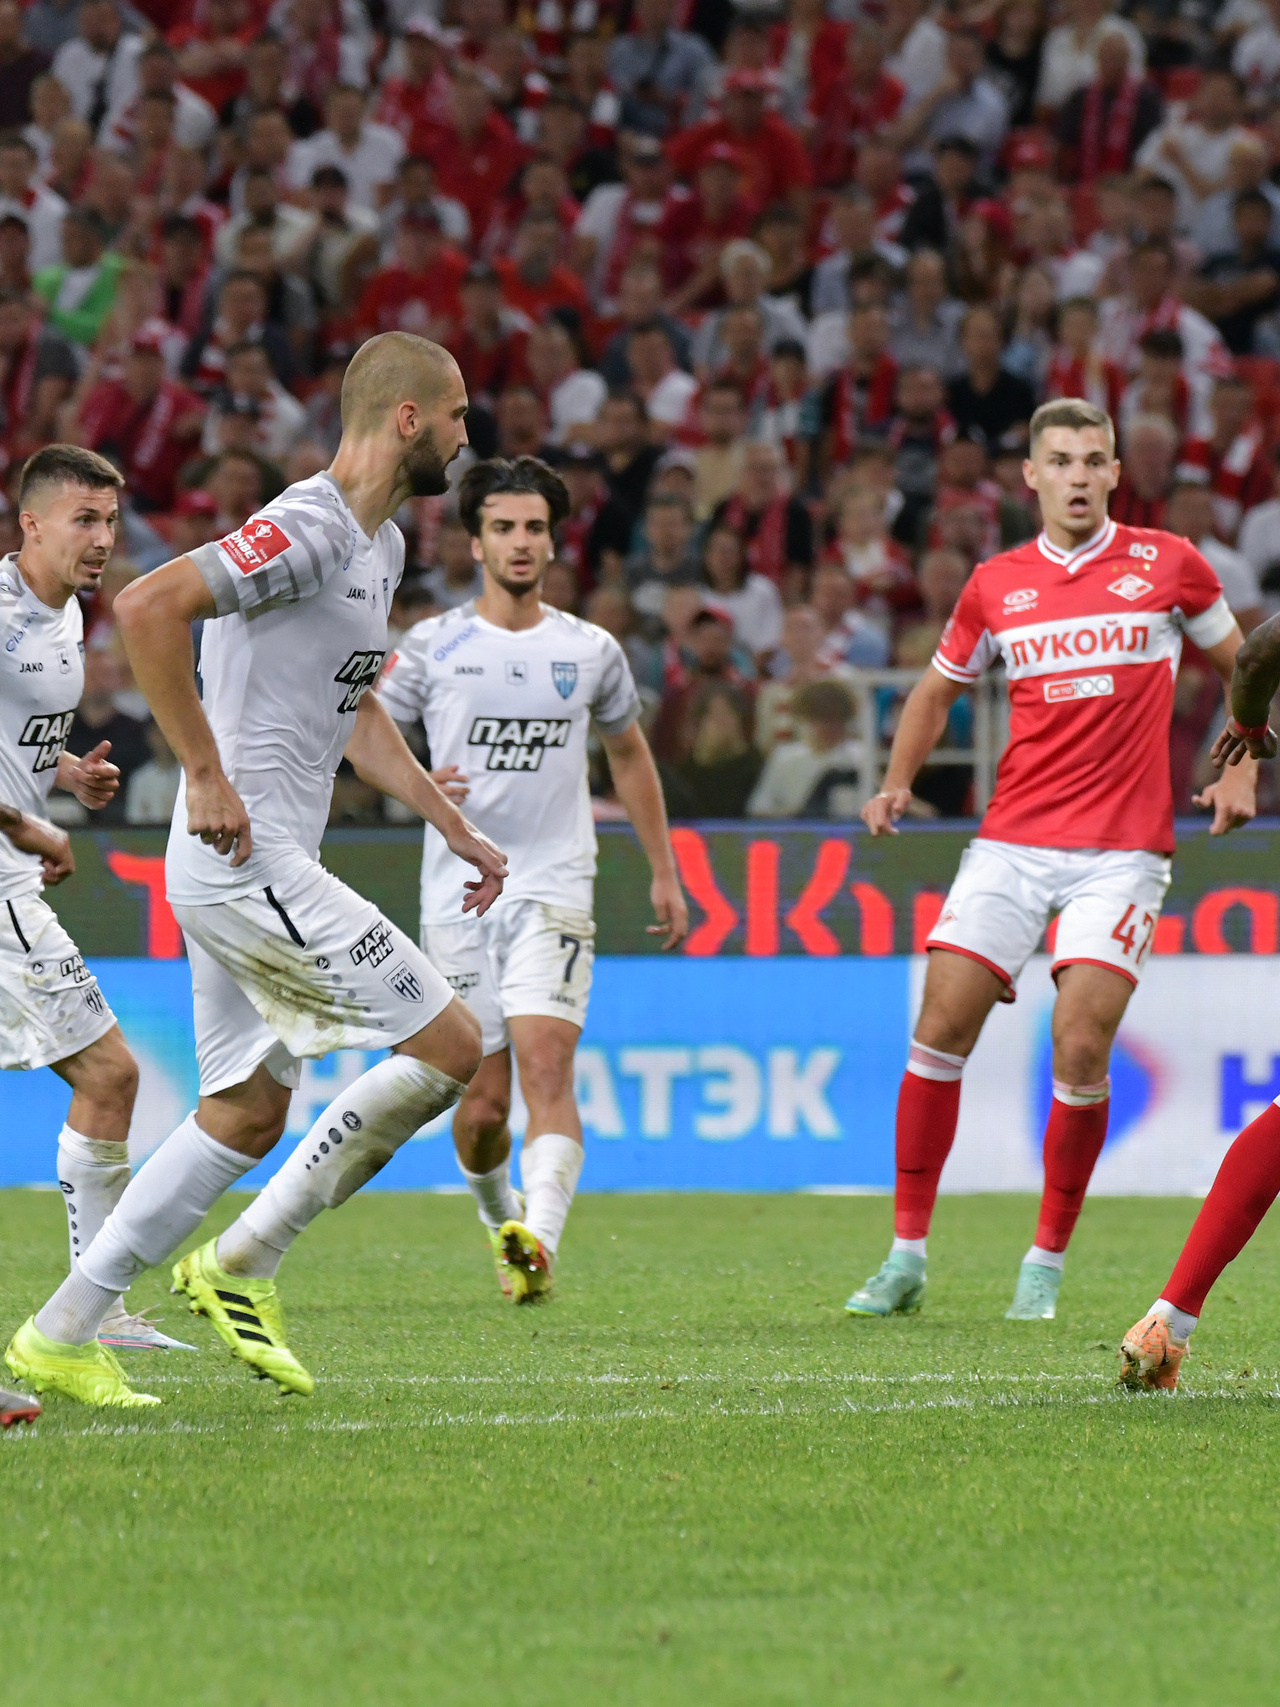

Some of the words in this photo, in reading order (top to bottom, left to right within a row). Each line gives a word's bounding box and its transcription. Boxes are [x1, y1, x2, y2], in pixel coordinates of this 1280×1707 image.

[346, 588, 367, 600] JAKO
[1010, 620, 1149, 667] ЛУКОЙЛ
[19, 662, 44, 673] JAKO
[454, 666, 484, 676] JAKO
[470, 719, 570, 745] ПАРИ
[489, 746, 543, 769] НН
[351, 922, 392, 964] ПАРИ
[1111, 903, 1153, 964] 47
[369, 940, 392, 967] НН
[559, 934, 581, 983] 7
[286, 1044, 843, 1140] НАТЭК
